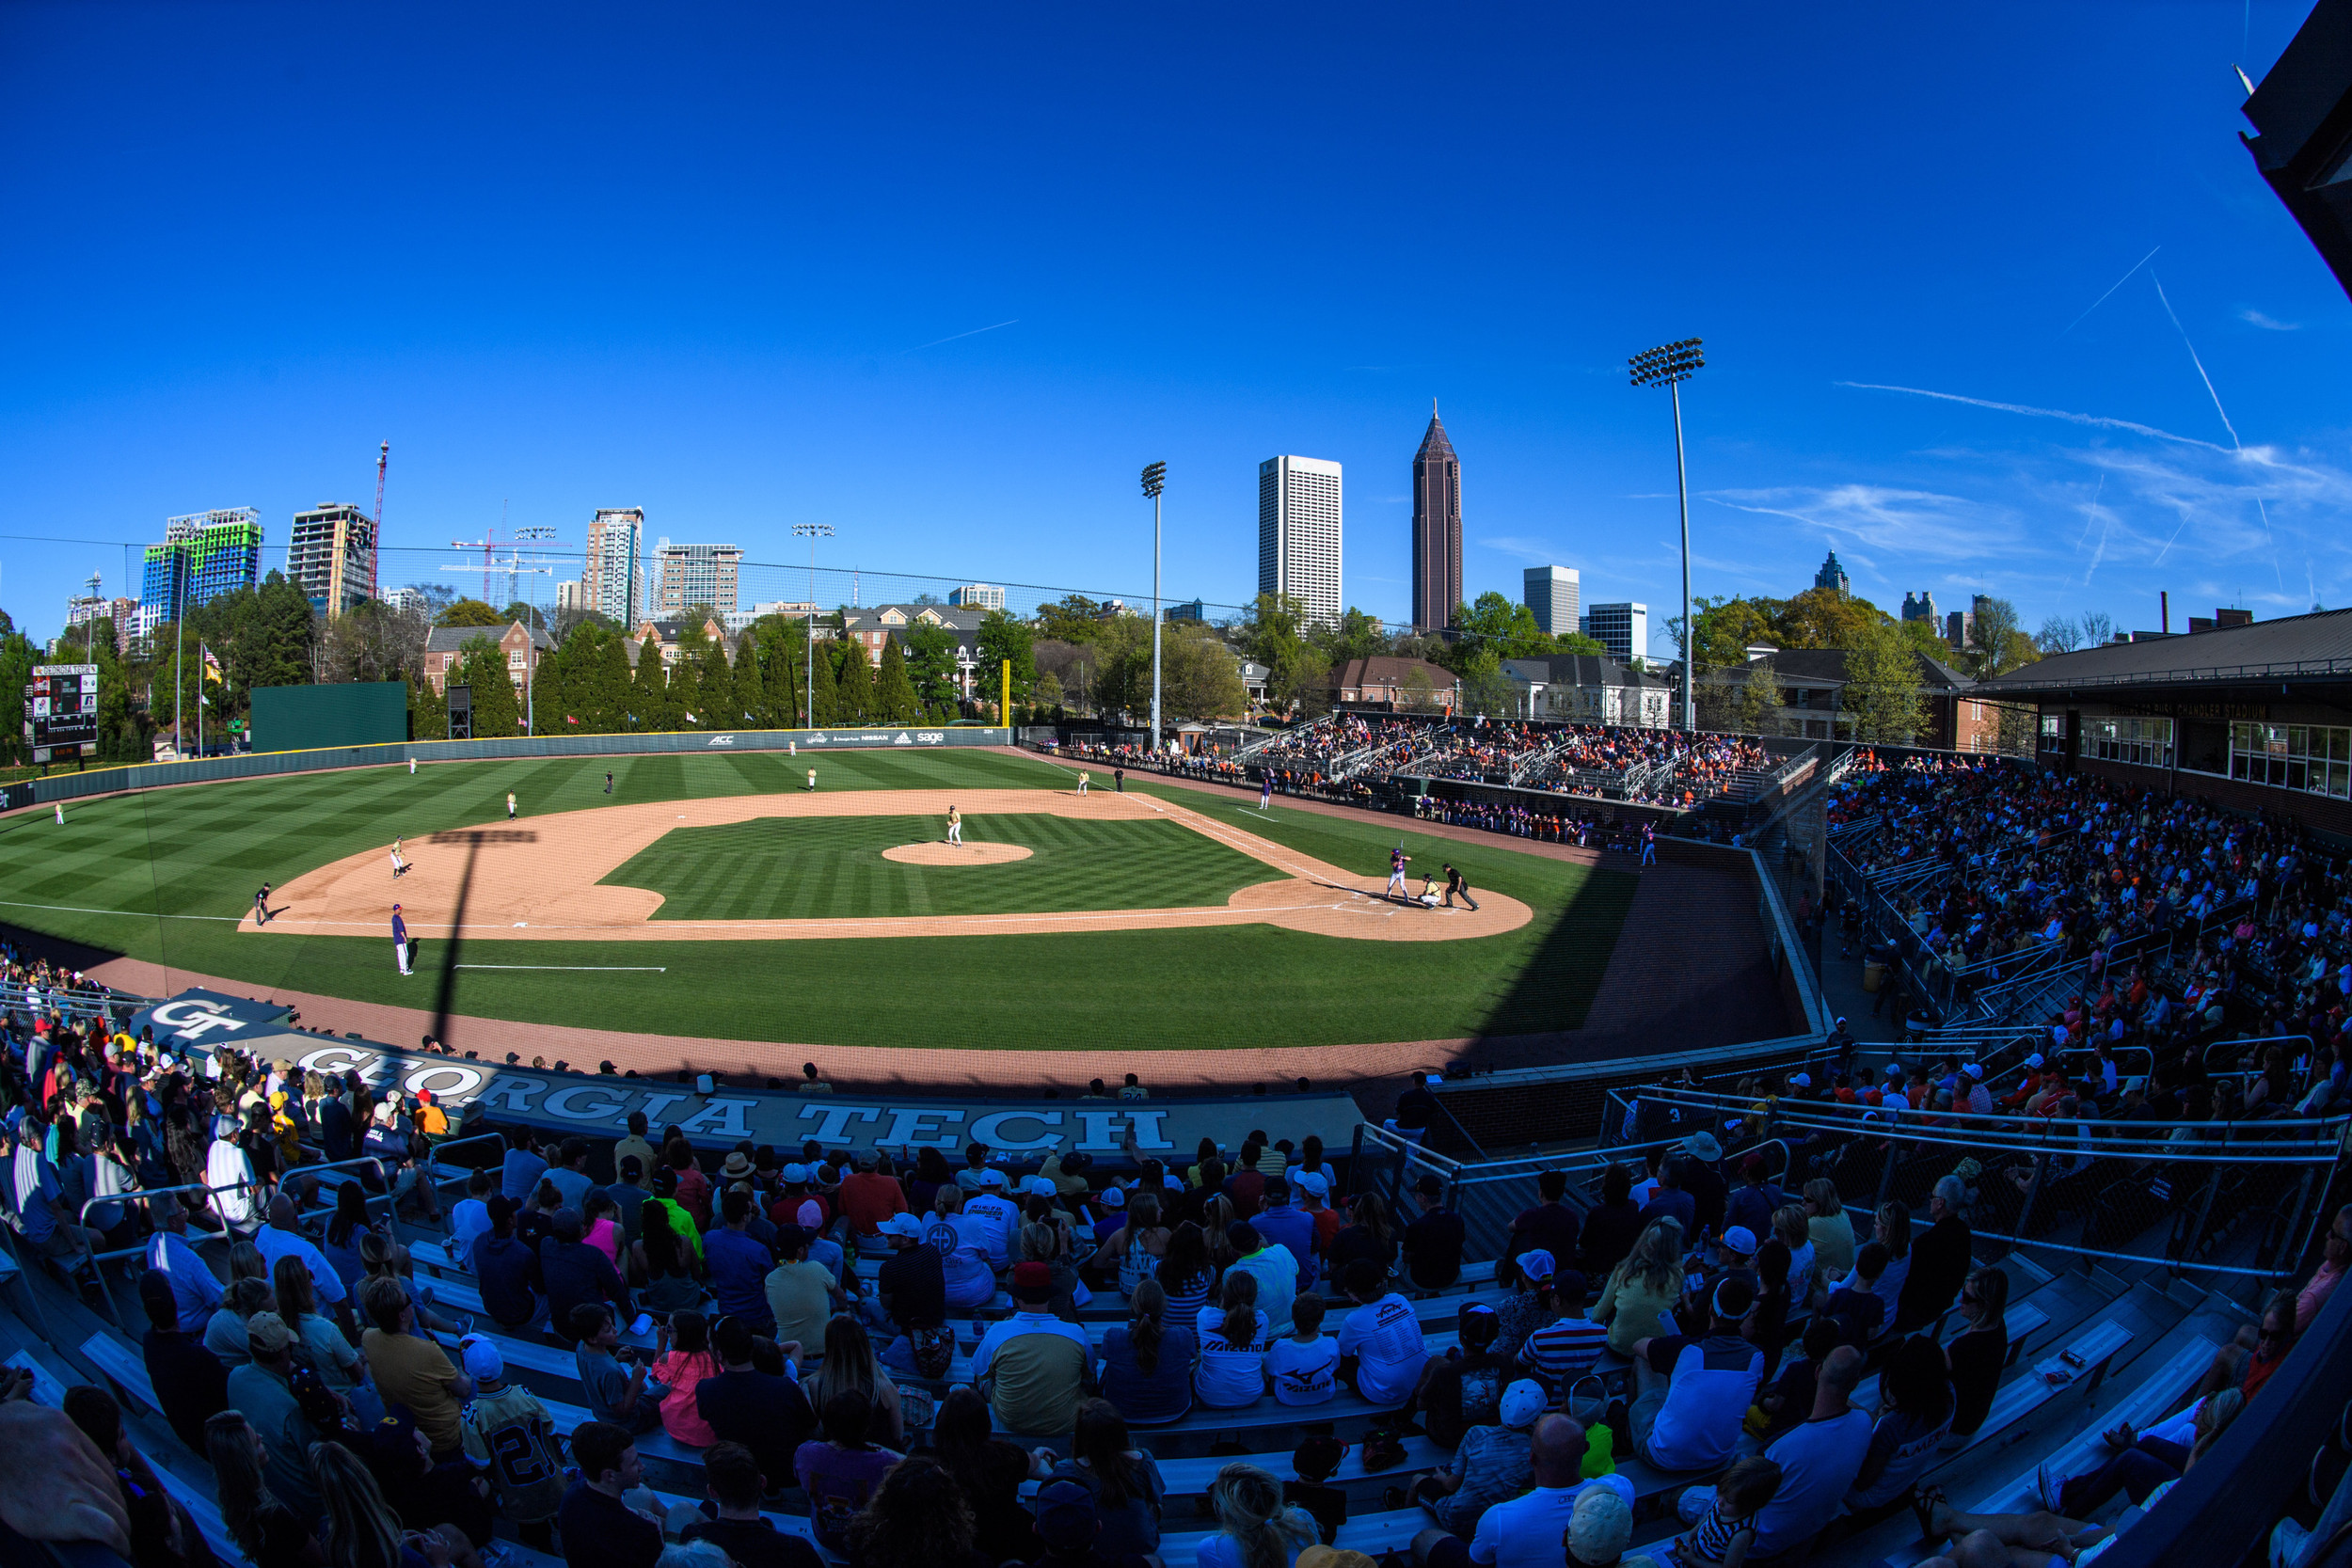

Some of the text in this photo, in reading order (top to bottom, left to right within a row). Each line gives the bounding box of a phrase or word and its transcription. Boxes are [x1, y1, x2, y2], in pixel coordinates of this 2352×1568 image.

[43, 664, 90, 675] GEORGIA TECH
[2176, 703, 2221, 717] CHANDLER
[2224, 704, 2266, 720] STADIUM
[708, 736, 735, 744] ACC
[916, 732, 944, 744] sage
[1464, 787, 1528, 808] GEORGIA
[1567, 800, 1615, 825] TECH
[151, 998, 248, 1040] GT
[297, 1047, 1177, 1150] GEORGIA TECH
[491, 1418, 557, 1488] 21
